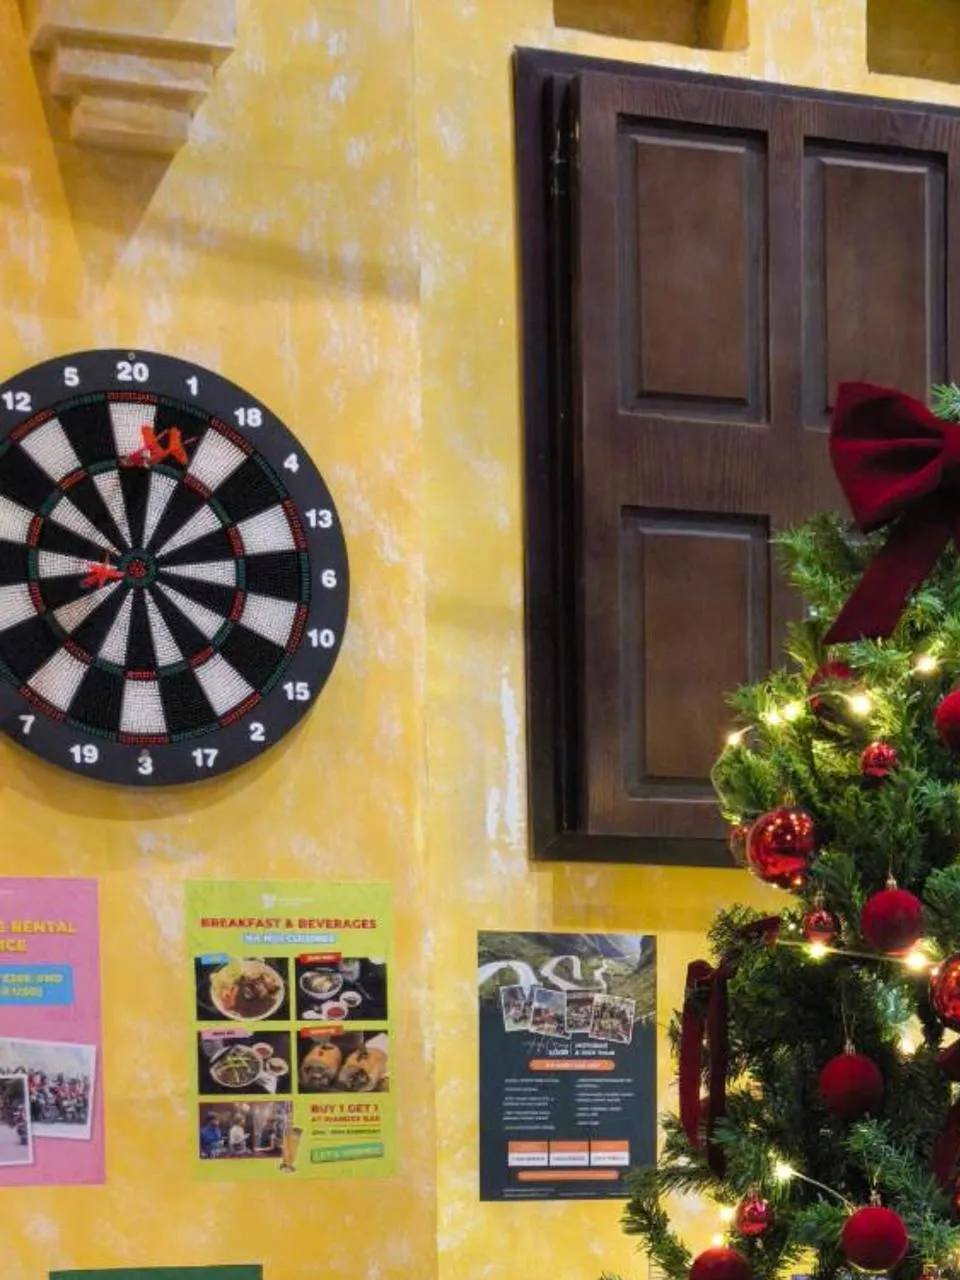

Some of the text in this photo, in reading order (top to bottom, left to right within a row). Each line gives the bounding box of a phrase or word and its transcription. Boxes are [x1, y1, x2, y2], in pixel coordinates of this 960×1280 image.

[64, 367, 80, 386] 5
[117, 362, 149, 382] 20
[187, 376, 198, 395] 1
[2, 391, 32, 411] 12
[234, 408, 262, 426] 18
[284, 453, 300, 473] 4
[306, 509, 333, 528] 13
[321, 569, 337, 588] 6
[308, 629, 335, 648] 10
[283, 682, 310, 701] 15
[20, 715, 35, 734] 7
[249, 722, 265, 742] 2
[69, 744, 99, 764] 19
[192, 749, 219, 767] 17
[137, 756, 153, 775] 3
[11, 919, 77, 933] RENTAL
[200, 917, 377, 930] BREAKFAST & BEVERAGES
